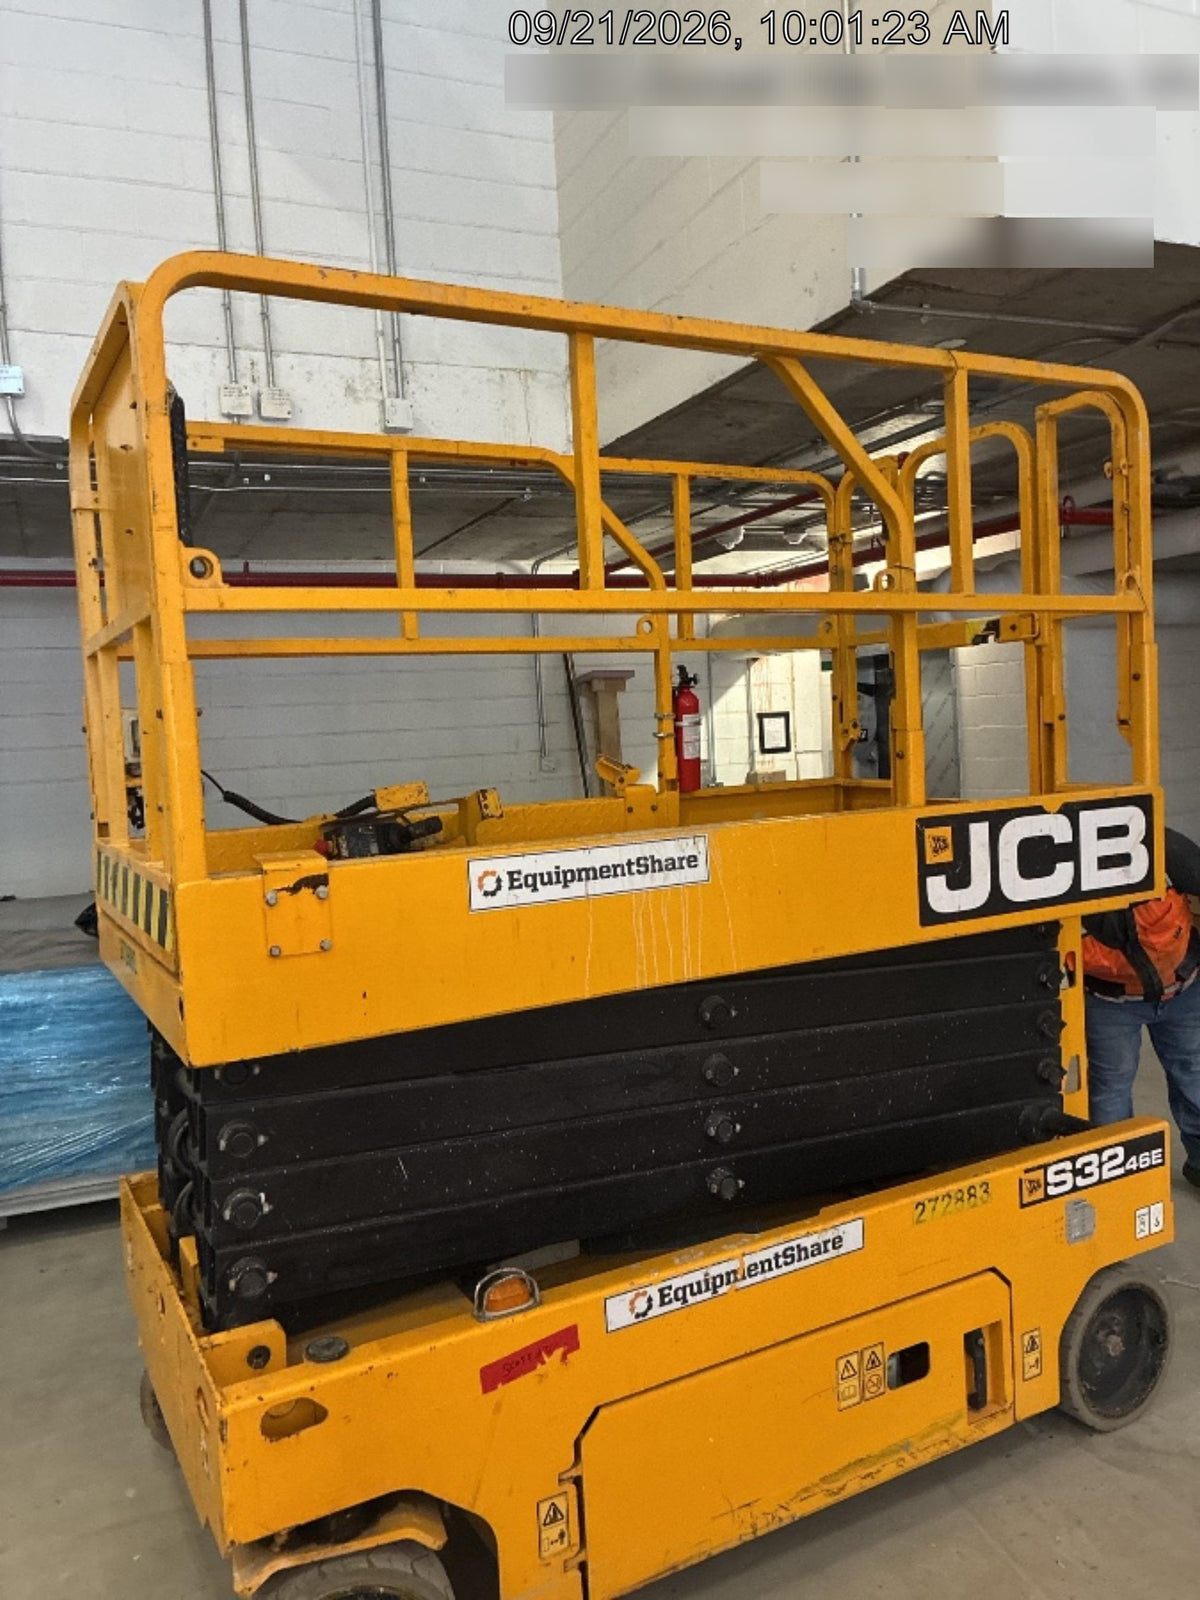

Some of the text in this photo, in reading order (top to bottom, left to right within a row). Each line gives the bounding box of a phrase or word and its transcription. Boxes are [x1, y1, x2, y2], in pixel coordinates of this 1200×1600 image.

[506, 854, 699, 892] EquipmentShare
[925, 805, 1149, 914] JCB
[914, 1181, 990, 1224] 272883
[657, 1235, 844, 1309] EquipmentShare
